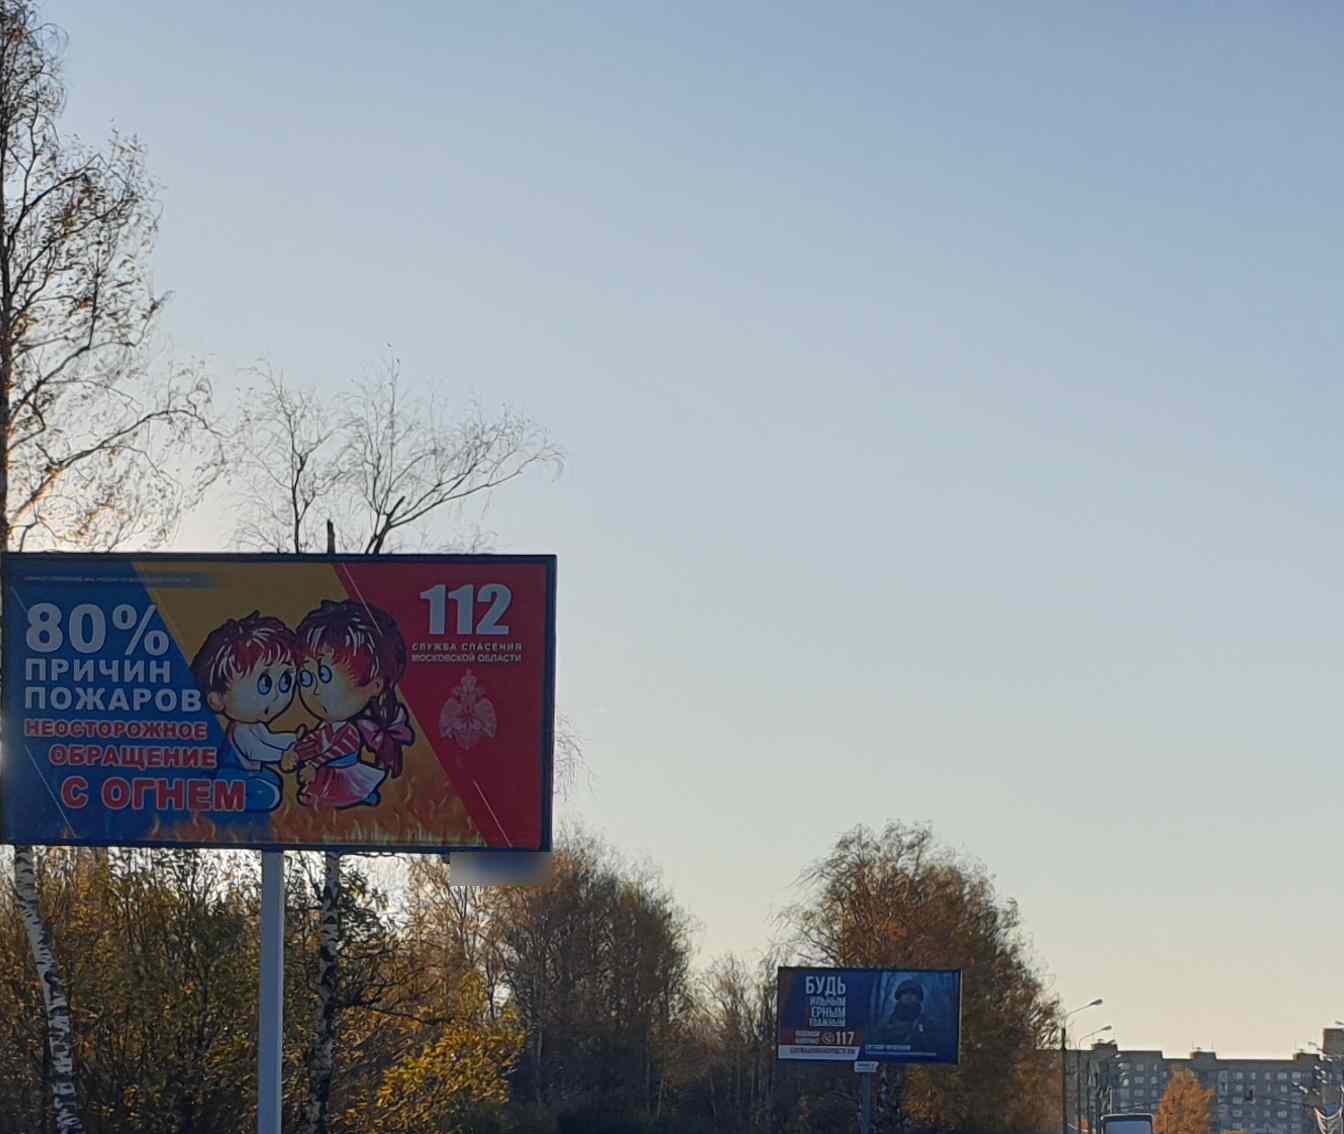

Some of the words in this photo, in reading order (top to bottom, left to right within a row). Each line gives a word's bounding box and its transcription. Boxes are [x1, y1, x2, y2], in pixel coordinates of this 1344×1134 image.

[419, 583, 512, 635] 112
[25, 602, 170, 656] 80%
[25, 658, 170, 683] ПРИЧИН
[24, 686, 201, 712] ПОЖАРОВ
[24, 719, 208, 740] НЕОСТОРОЖНОЕ
[48, 744, 217, 770] ОБРАЩЕНИЕ
[61, 776, 89, 808] С
[101, 777, 246, 812] ОГНЕМ
[806, 976, 846, 996] БУДЬ
[836, 1031, 855, 1045] 117
